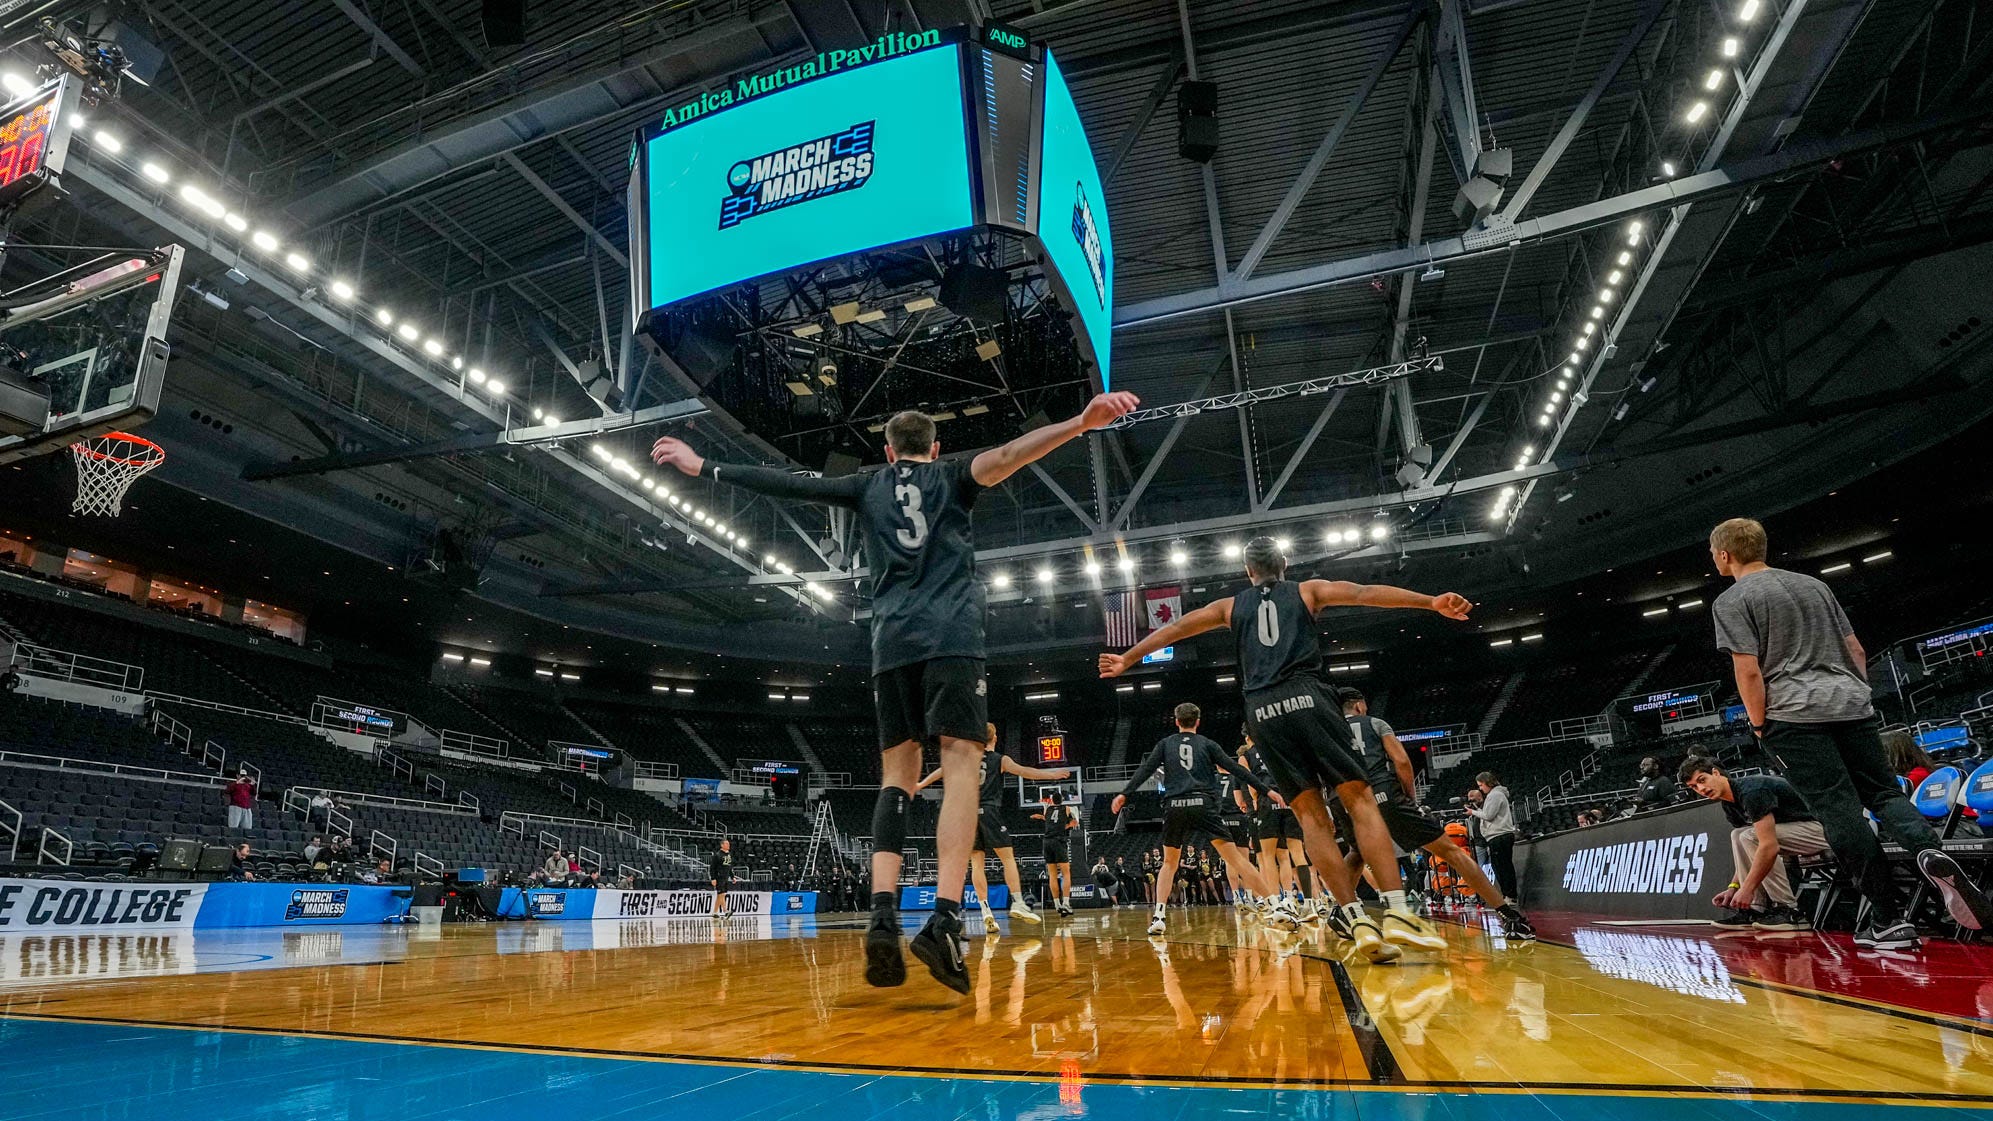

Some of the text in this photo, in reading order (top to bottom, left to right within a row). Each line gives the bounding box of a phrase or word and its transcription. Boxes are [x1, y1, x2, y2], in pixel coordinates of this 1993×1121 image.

[990, 28, 1027, 49] AMP
[660, 28, 942, 131] Amica Mutual Pavilion
[750, 138, 832, 184] MARCH
[760, 152, 873, 206] MADNESS
[895, 484, 929, 549] 3
[56, 588, 70, 599] 212
[1257, 600, 1280, 647] 0
[249, 636, 259, 646] 213
[111, 694, 128, 705] 109
[1648, 692, 1672, 702] FIRST
[354, 706, 376, 716] FIRST
[1255, 695, 1315, 723] PLAY HARD
[1633, 700, 1664, 712] SECOND
[338, 711, 366, 722] SECOND
[1041, 738, 1061, 747] 40:00
[1044, 746, 1060, 760] 30
[1179, 743, 1194, 771] 9
[1220, 780, 1230, 798] 7
[1375, 791, 1389, 804] RD
[1050, 809, 1059, 823] 4
[1562, 832, 1709, 894] #MARCHMADNESS
[301, 891, 333, 903] MARCH
[538, 894, 557, 903] MARCH
[619, 892, 760, 916] FIRST AND SECOND OUNDS
[25, 887, 192, 926] COLLEGE
[303, 902, 345, 914] MADNESS
[540, 903, 564, 911] MADNESS
